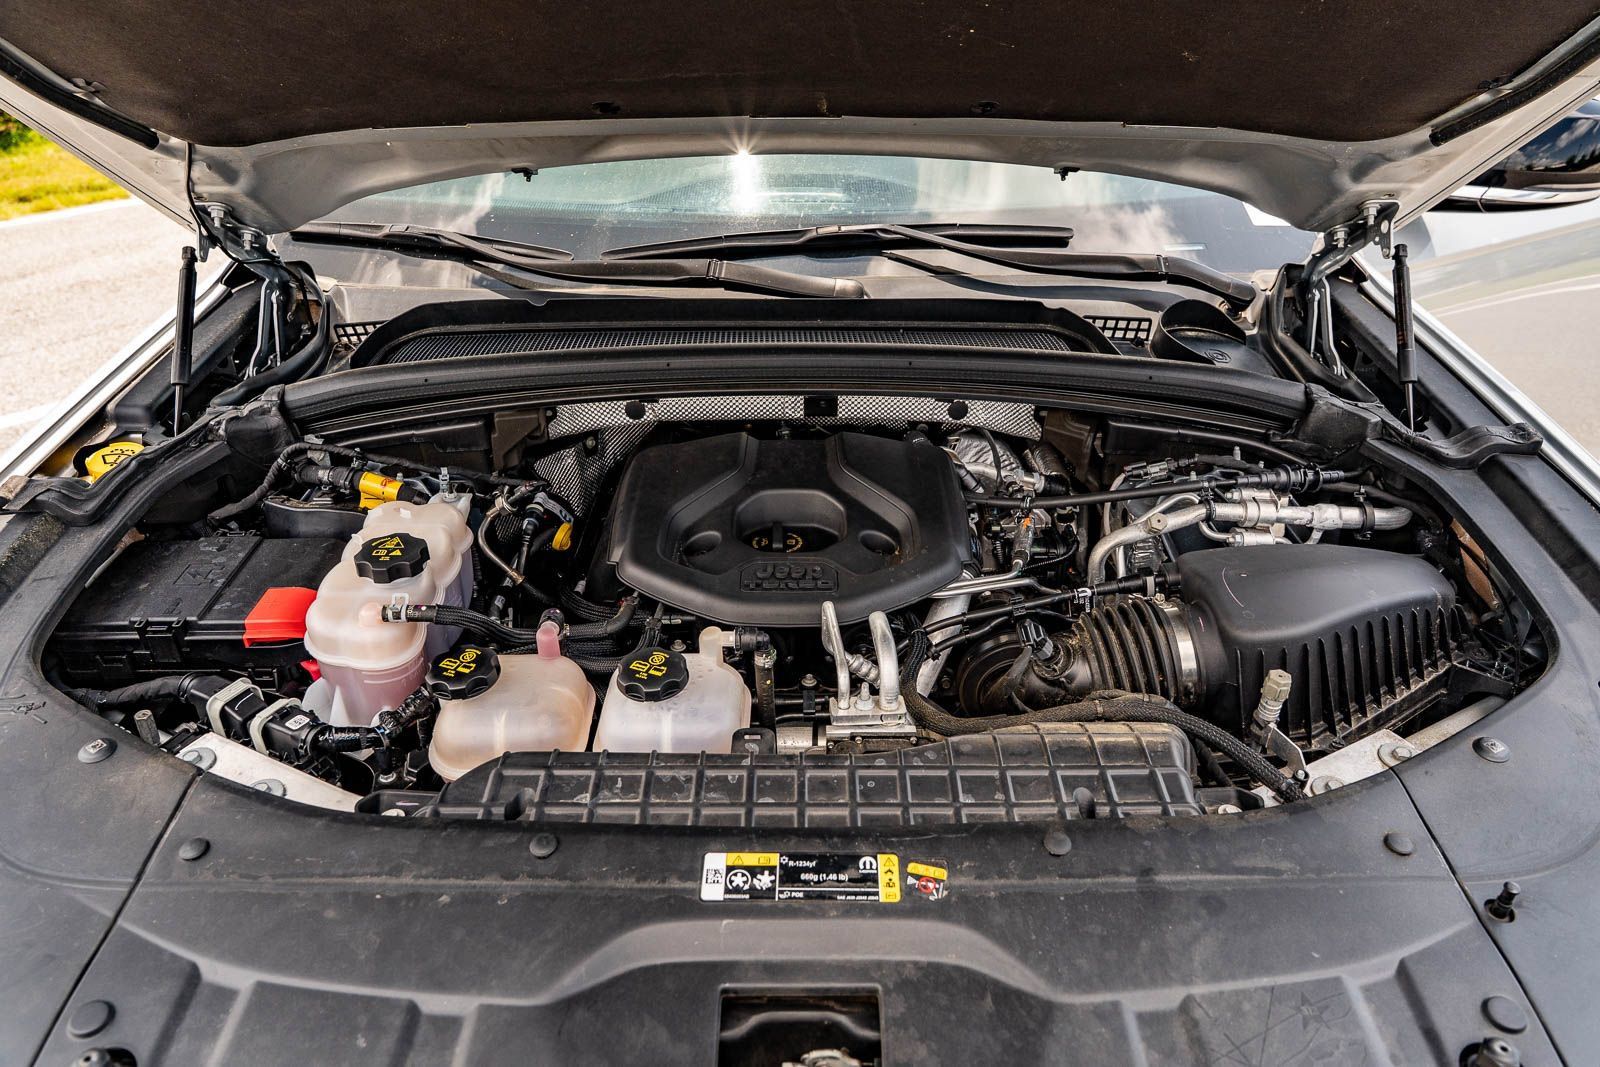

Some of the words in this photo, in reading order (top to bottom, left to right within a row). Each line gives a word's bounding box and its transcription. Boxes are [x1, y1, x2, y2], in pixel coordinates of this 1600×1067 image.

[756, 564, 823, 579] Jeep
[788, 860, 816, 868] R-1234yf
[800, 873, 818, 881] 660g
[838, 873, 849, 881] lb)
